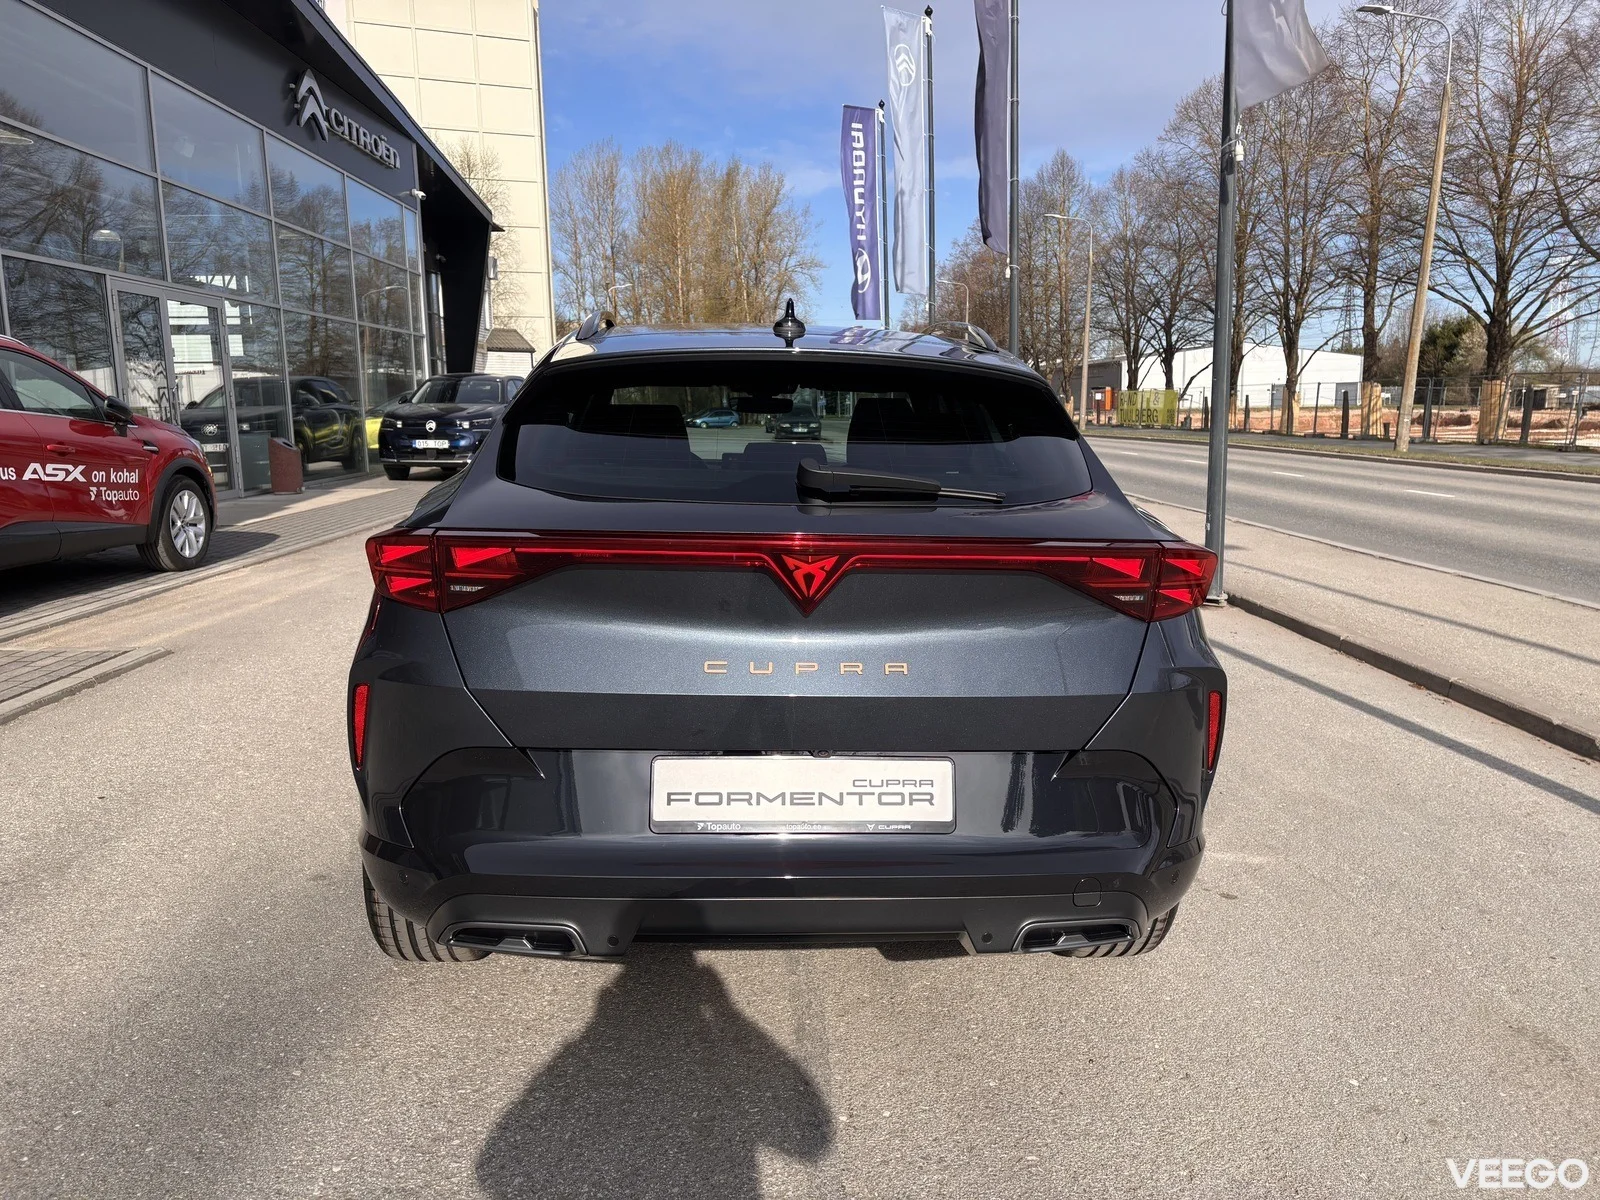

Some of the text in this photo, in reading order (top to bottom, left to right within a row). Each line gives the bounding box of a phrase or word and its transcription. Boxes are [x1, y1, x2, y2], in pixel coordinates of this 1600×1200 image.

[330, 107, 400, 169] CITROËN
[22, 462, 87, 482] ASX
[91, 470, 106, 482] on
[110, 468, 139, 483] kohal
[100, 487, 140, 504] Topauto
[703, 660, 909, 675] CUPRA
[852, 779, 934, 788] CUPRA
[666, 791, 935, 806] FORMENTOR
[706, 822, 741, 831] Topauto
